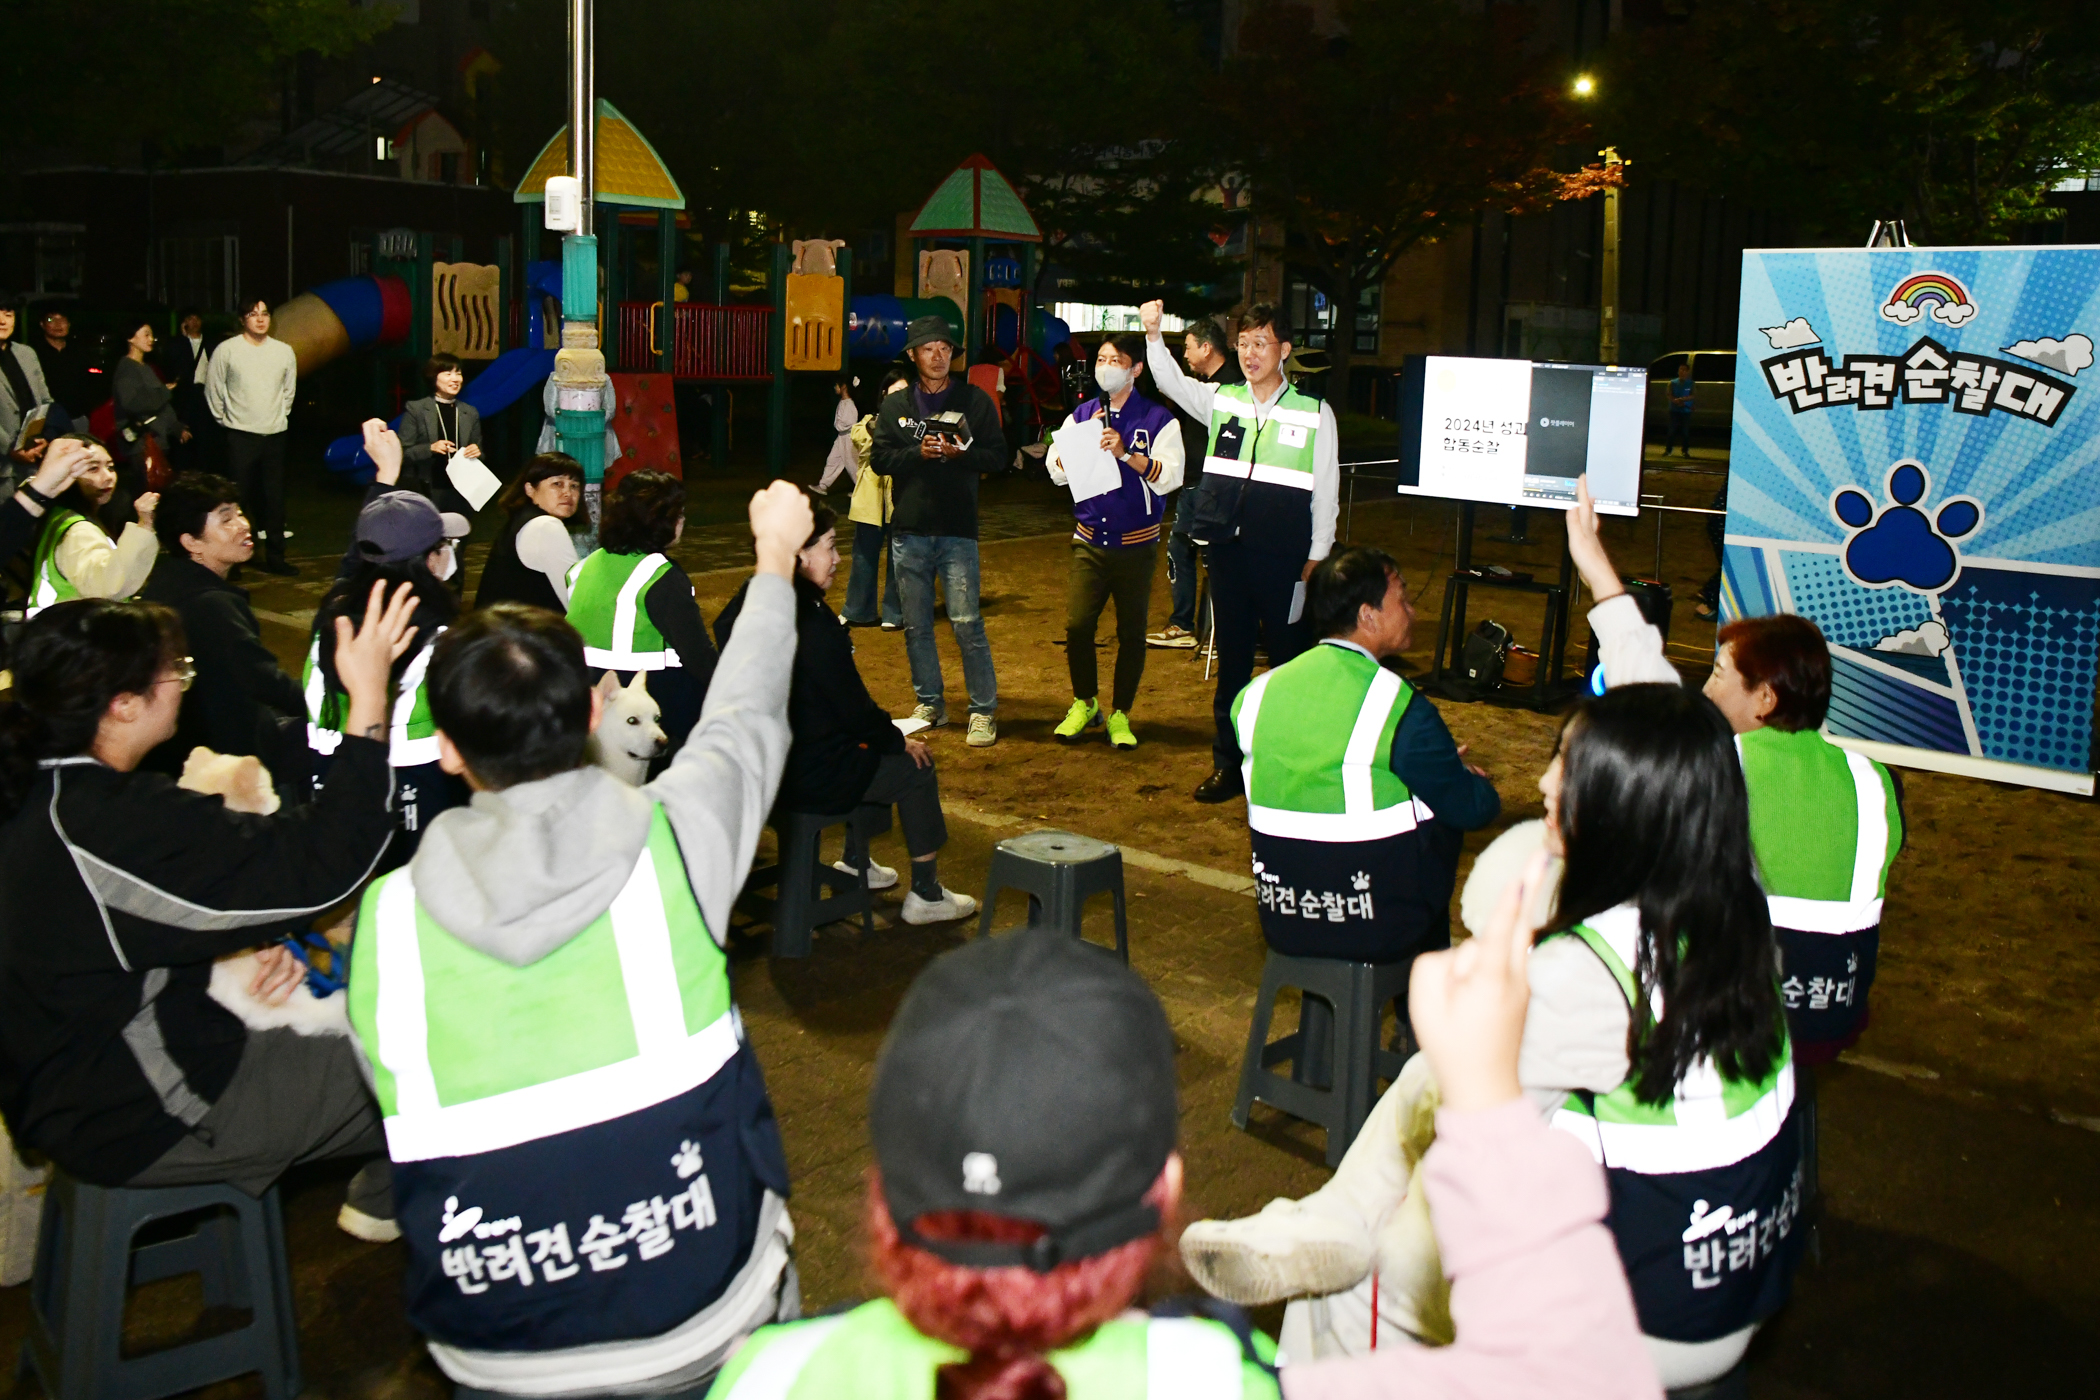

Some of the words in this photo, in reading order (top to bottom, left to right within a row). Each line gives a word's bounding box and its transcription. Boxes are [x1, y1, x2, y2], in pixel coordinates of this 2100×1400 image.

[1766, 343, 2068, 423] 반려견순찰대
[1444, 437, 1500, 454] 합동순찰
[1445, 418, 1494, 433] 2024년
[441, 1173, 718, 1295] 반려견순찰대
